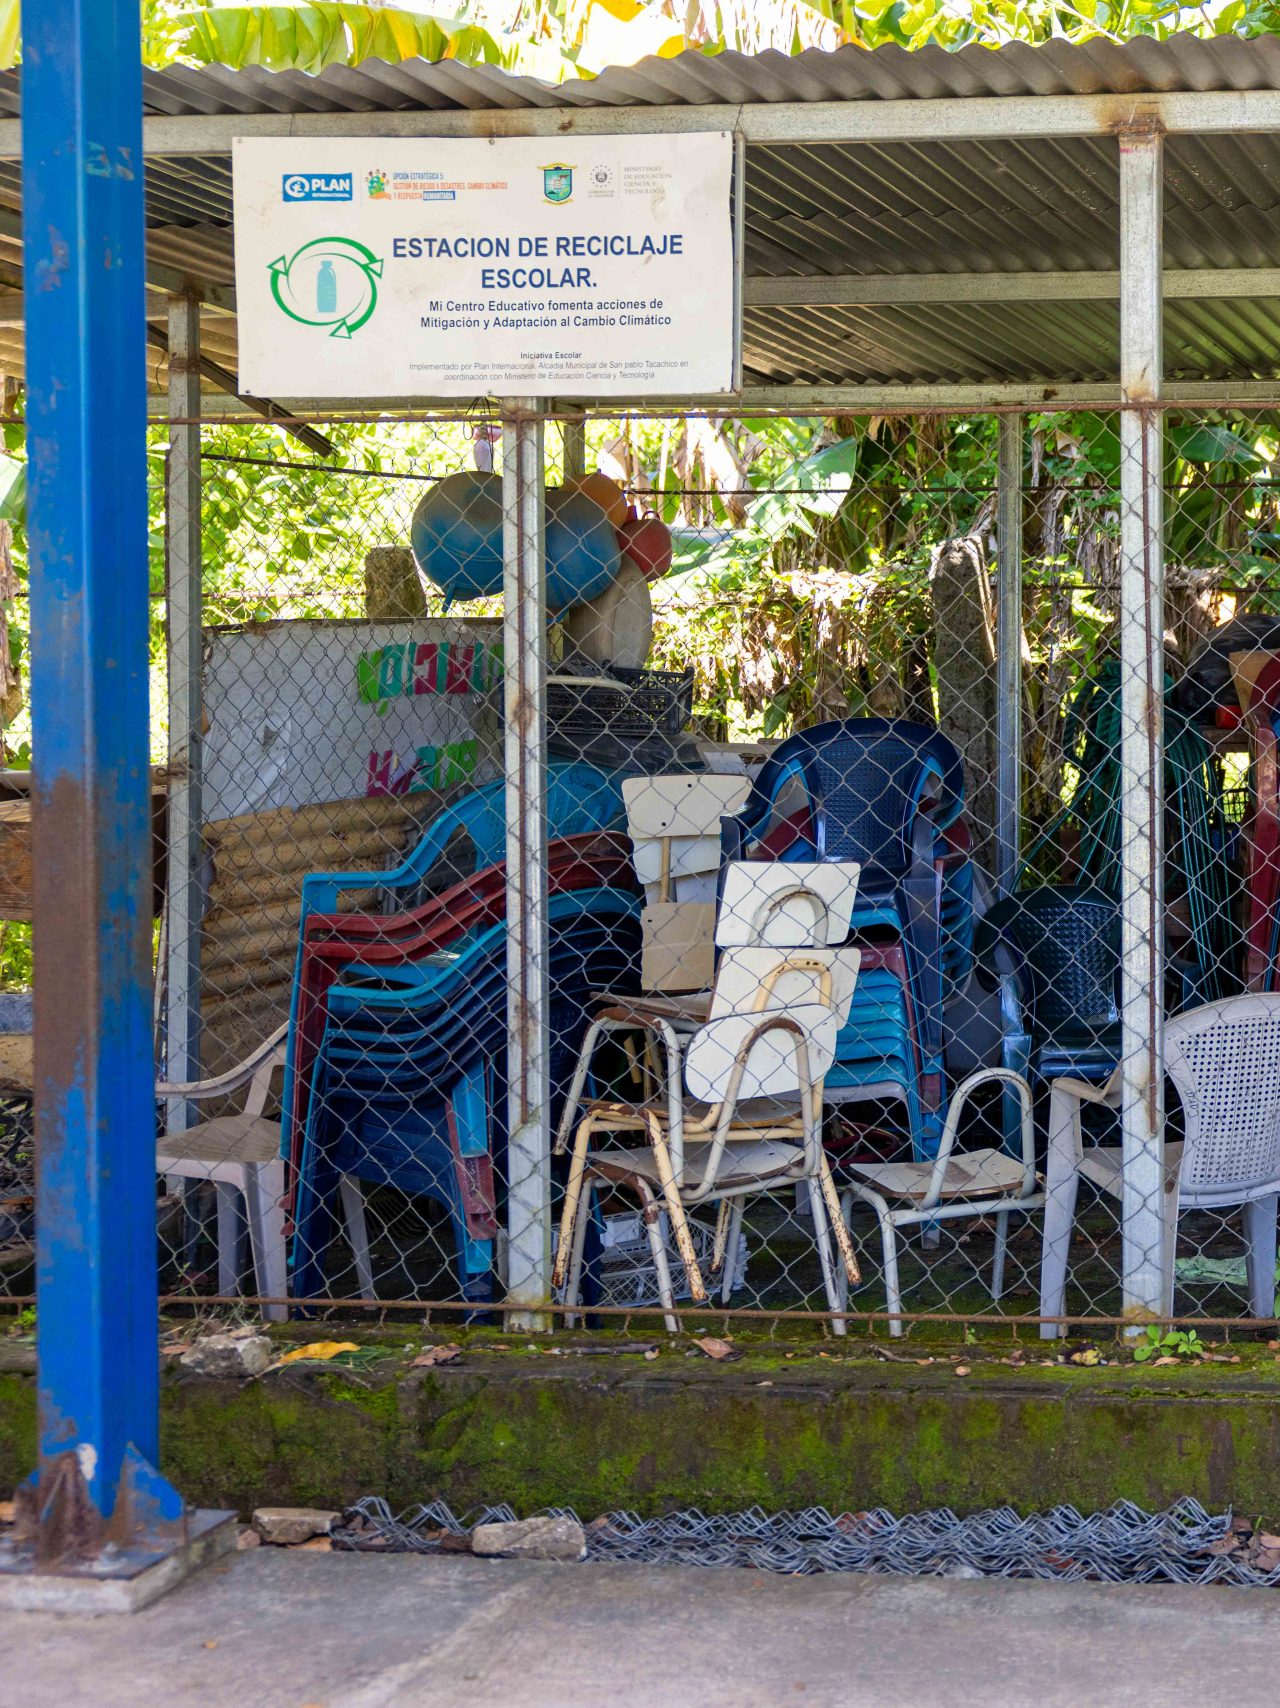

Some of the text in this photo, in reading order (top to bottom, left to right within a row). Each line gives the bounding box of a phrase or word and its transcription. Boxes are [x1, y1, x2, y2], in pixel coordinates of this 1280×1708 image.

[311, 178, 350, 191] PLAN
[393, 235, 684, 259] ESTACION DE RECICLAJE
[481, 268, 598, 289] ESCOLAR.
[430, 299, 664, 312] Mi Centro Educativo fomenta acciones de
[421, 315, 672, 330] Mitigación y Adaptación al Cambio Climático
[521, 351, 582, 360] Iniciativa Escolar
[410, 363, 459, 372] Implementado
[461, 364, 472, 372] por
[474, 362, 490, 371] Plan
[566, 361, 598, 371] Municipal
[599, 361, 608, 369] de
[609, 360, 623, 369] San
[625, 360, 643, 370] pablo
[646, 360, 679, 369] Tacachico
[680, 361, 689, 369] en
[505, 372, 537, 382] Ministerio
[538, 372, 547, 381] de
[586, 371, 612, 380] Ciencia
